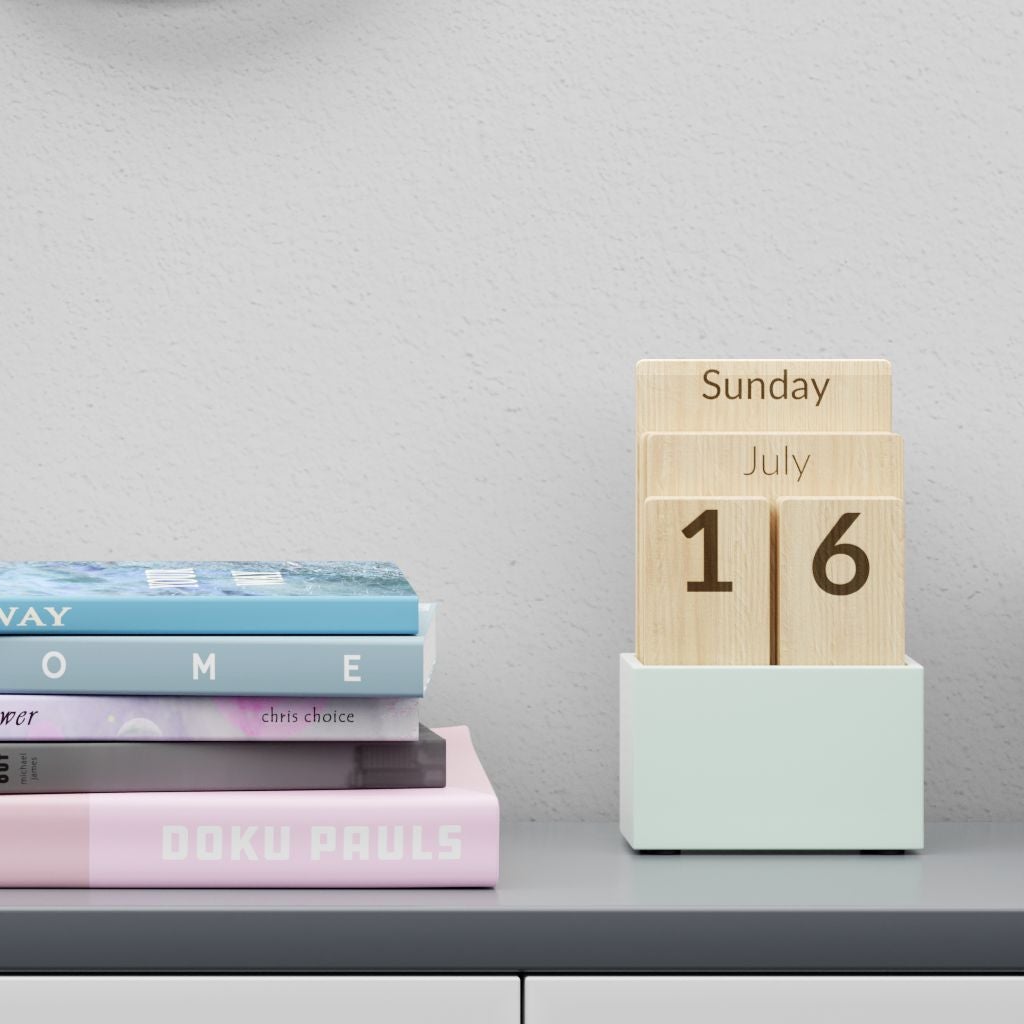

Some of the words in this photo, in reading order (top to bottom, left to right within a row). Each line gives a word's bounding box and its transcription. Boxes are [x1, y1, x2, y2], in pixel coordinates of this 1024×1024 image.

[701, 368, 830, 407] Sunday
[743, 445, 811, 482] July
[261, 706, 298, 723] chris
[304, 706, 355, 723] choice
[161, 824, 290, 861] DOKU
[310, 824, 462, 861] PAULS
